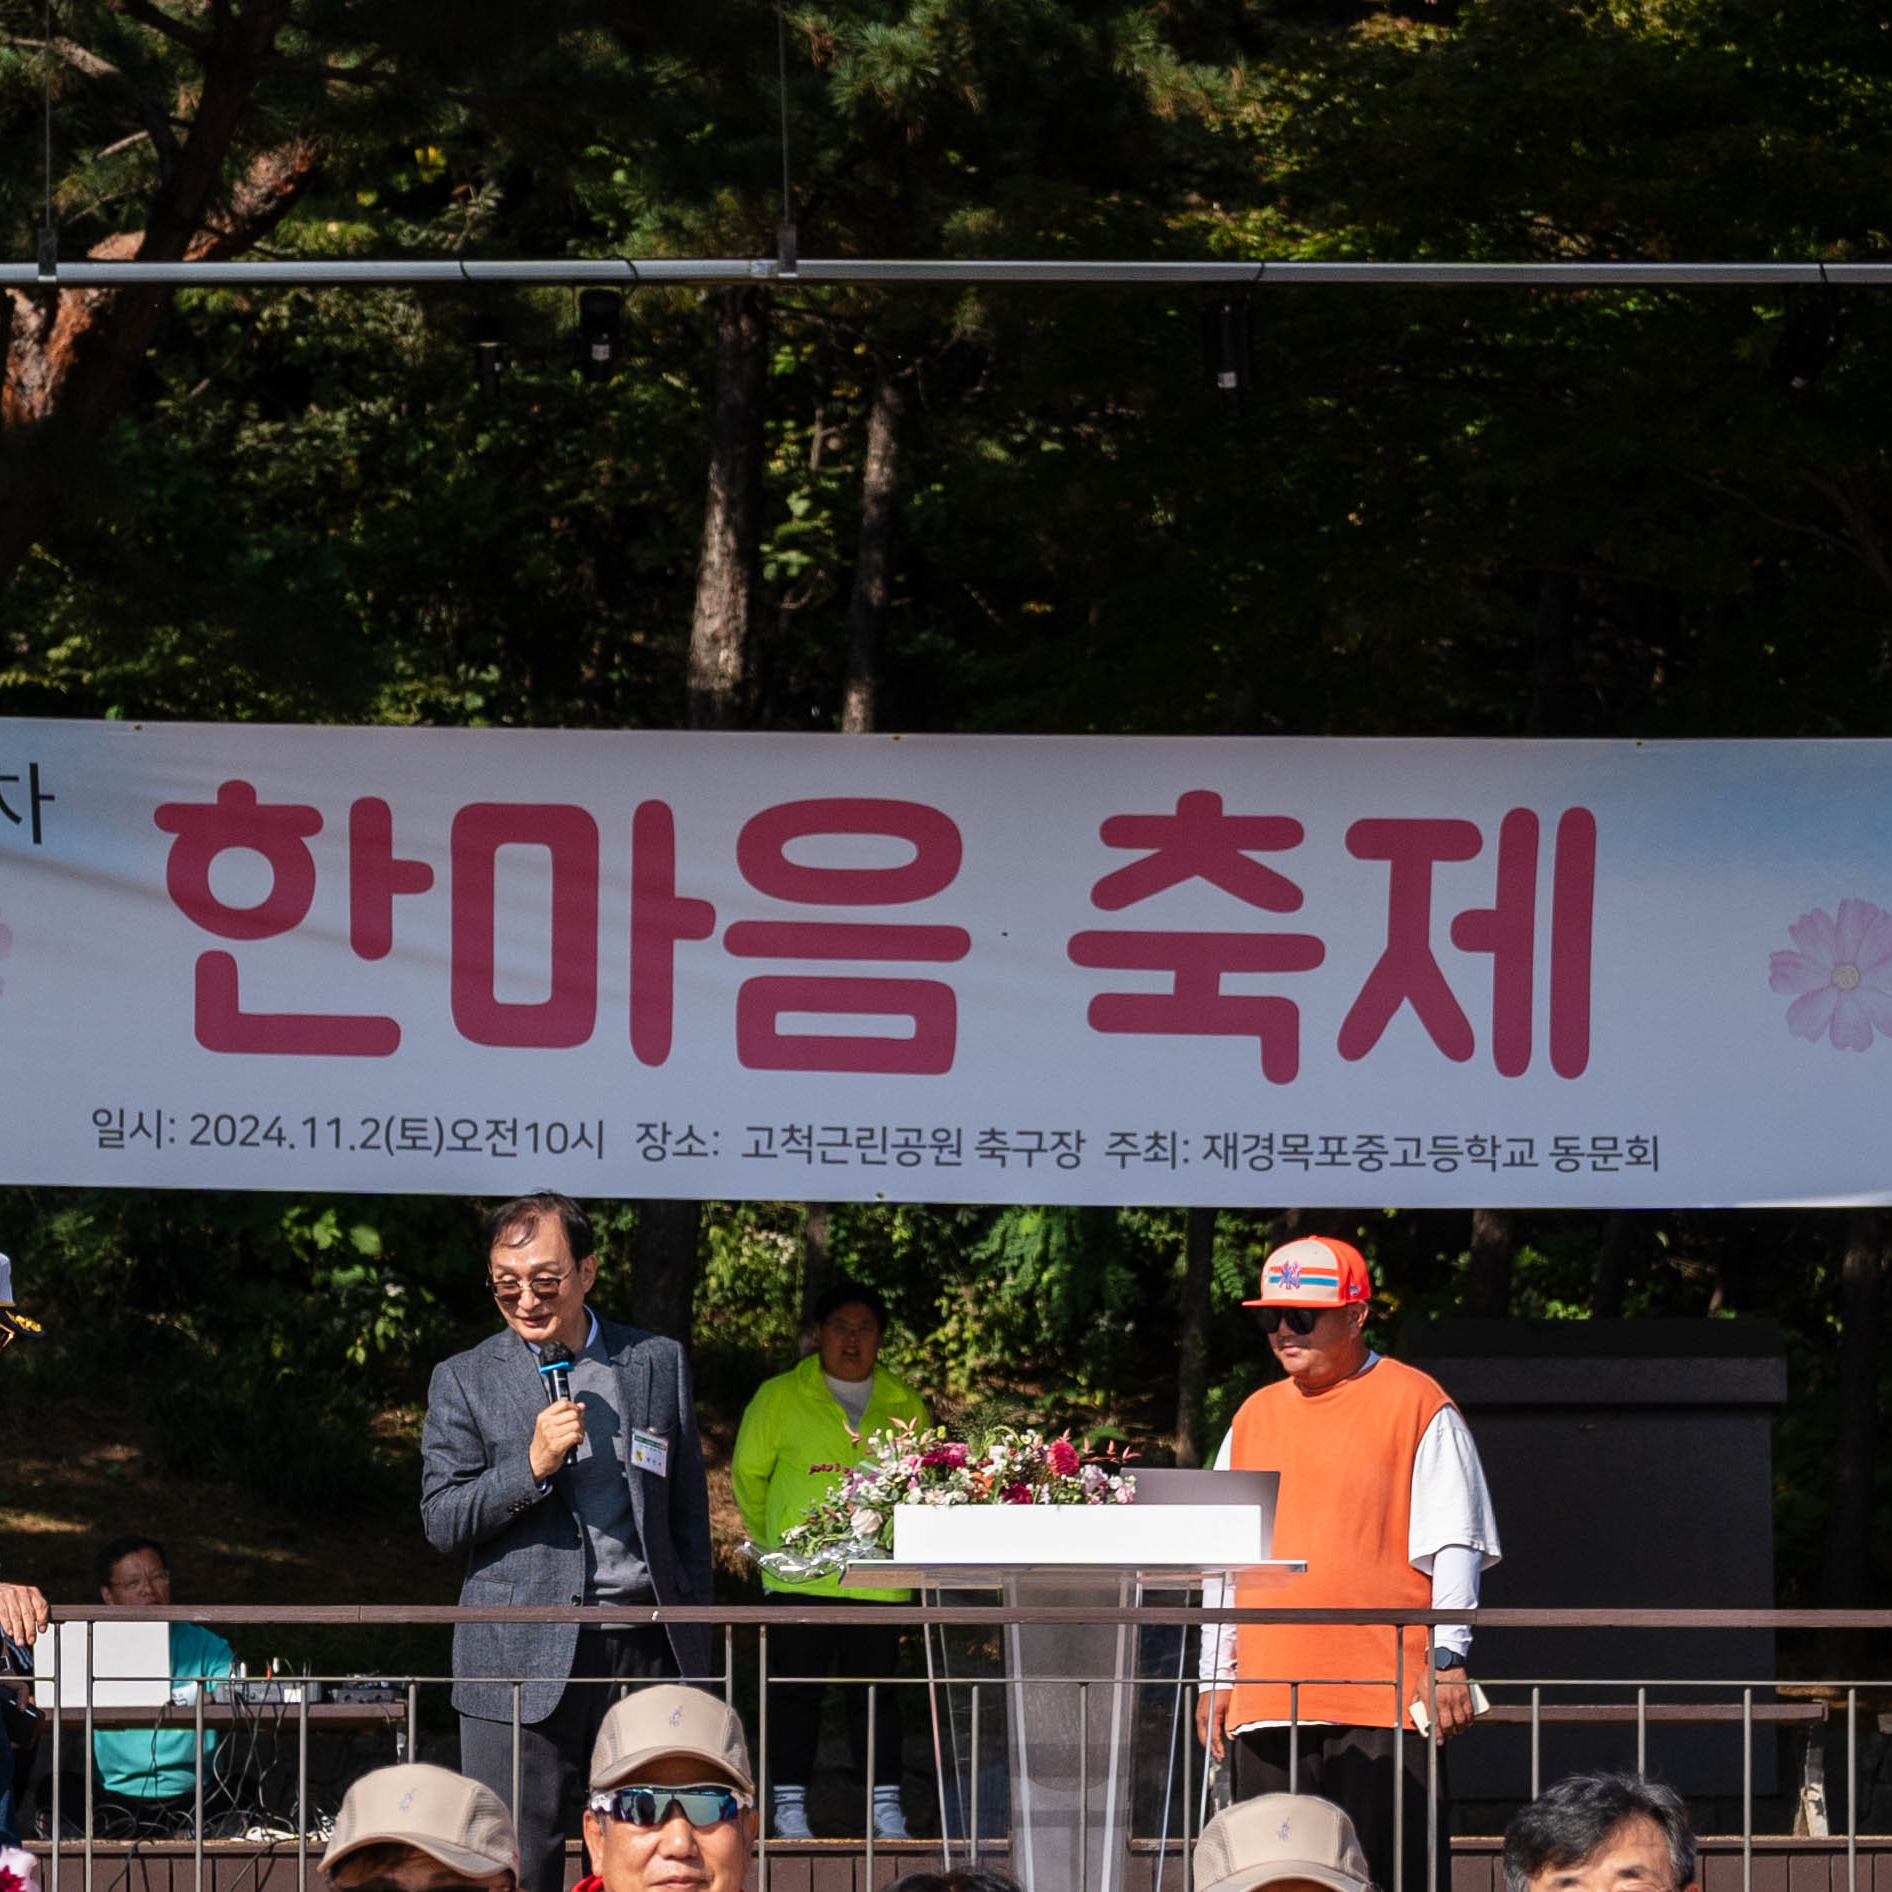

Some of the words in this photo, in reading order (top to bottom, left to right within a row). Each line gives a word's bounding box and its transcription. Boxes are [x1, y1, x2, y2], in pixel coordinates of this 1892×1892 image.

[153, 780, 973, 1075] 한마음
[1066, 790, 1597, 1085] 축제
[91, 1107, 176, 1150] 일시:
[189, 1113, 604, 1160] 2024.11.2(토)오전10시
[635, 1121, 720, 1163] 장소:
[740, 1123, 963, 1168] 고척근린공원
[974, 1127, 1087, 1170] 축구장
[1104, 1130, 1190, 1171] 주최:
[1202, 1131, 1539, 1173] 재경목포중고등학교
[1548, 1134, 1659, 1174] 동문회
